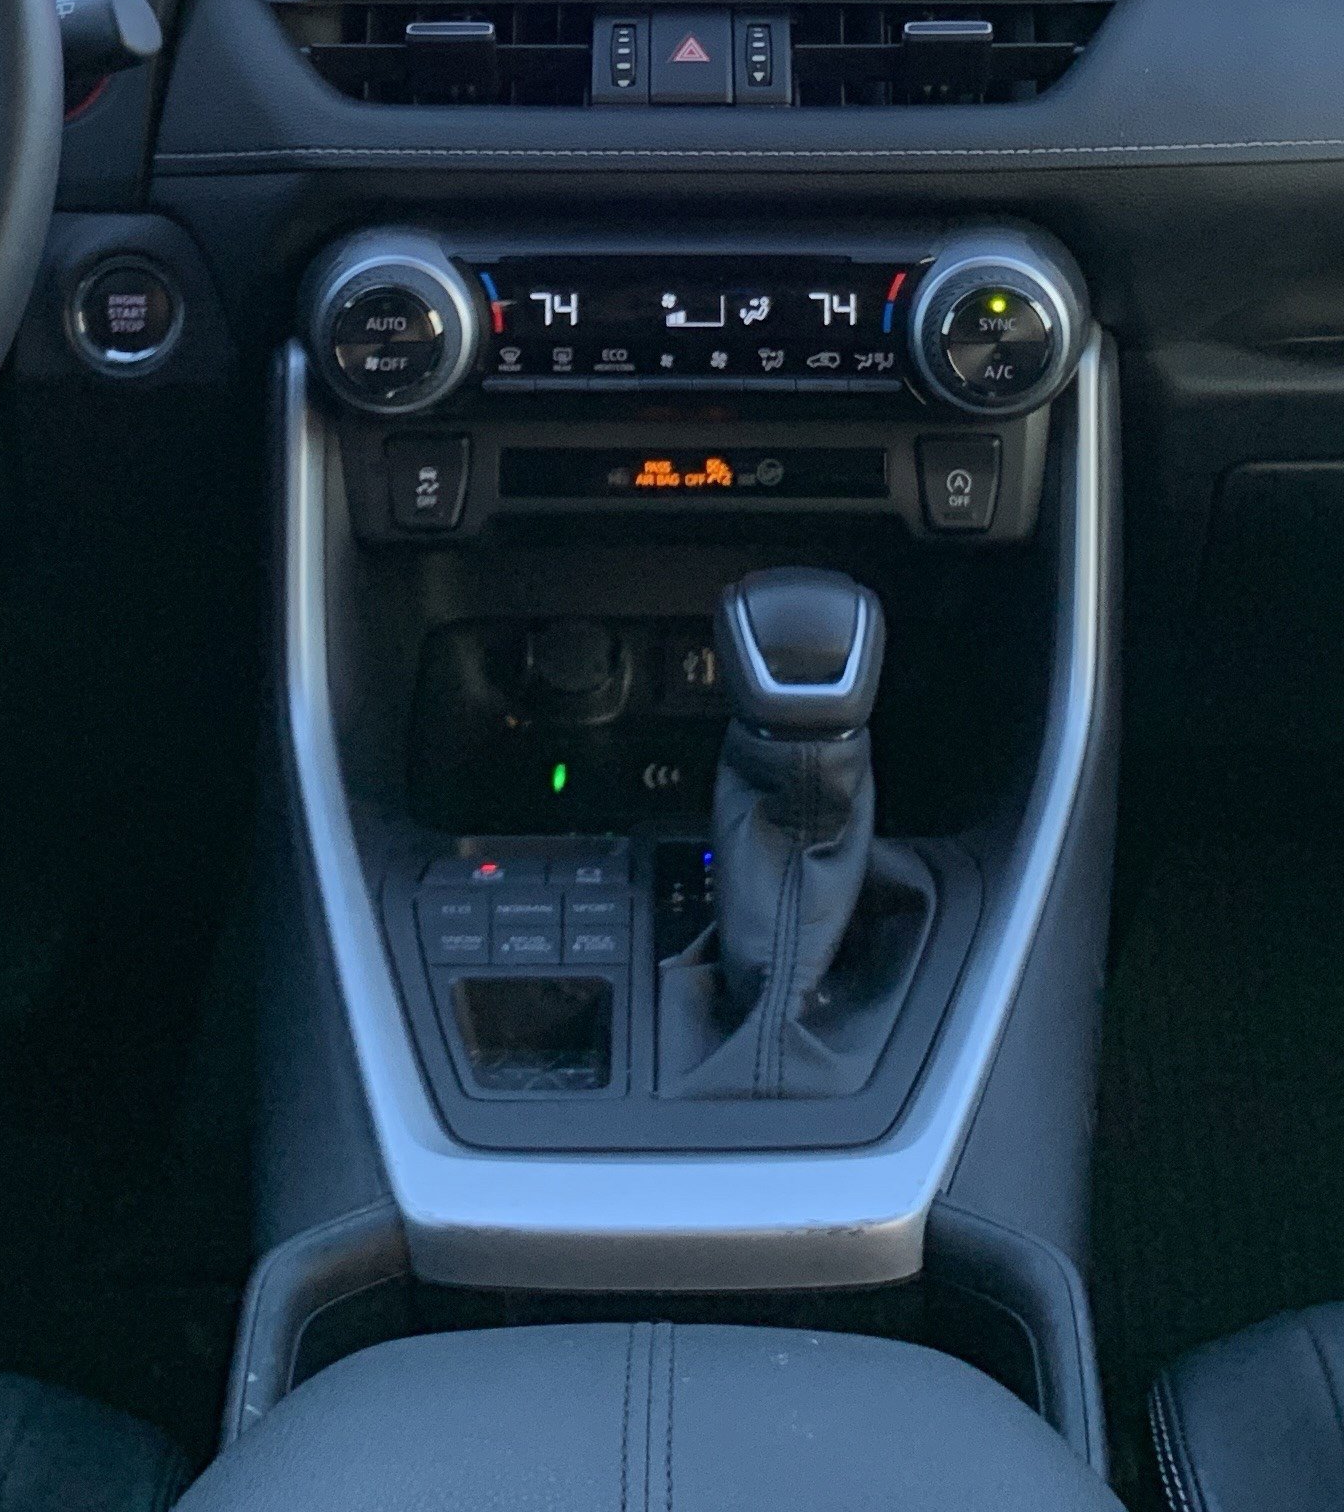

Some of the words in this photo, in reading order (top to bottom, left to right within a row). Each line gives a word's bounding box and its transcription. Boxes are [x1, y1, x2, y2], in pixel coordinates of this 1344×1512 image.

[108, 307, 147, 319] START
[530, 292, 579, 326] 74
[809, 292, 857, 326] 74
[111, 320, 145, 332] STOP
[366, 316, 407, 331] AUTO
[979, 317, 1018, 331] SYNC
[601, 348, 629, 362] ECO
[379, 357, 408, 371] OFF
[984, 364, 1014, 380] A/C
[644, 460, 671, 474] PASS
[954, 475, 965, 489] A
[948, 495, 971, 507] OFF
